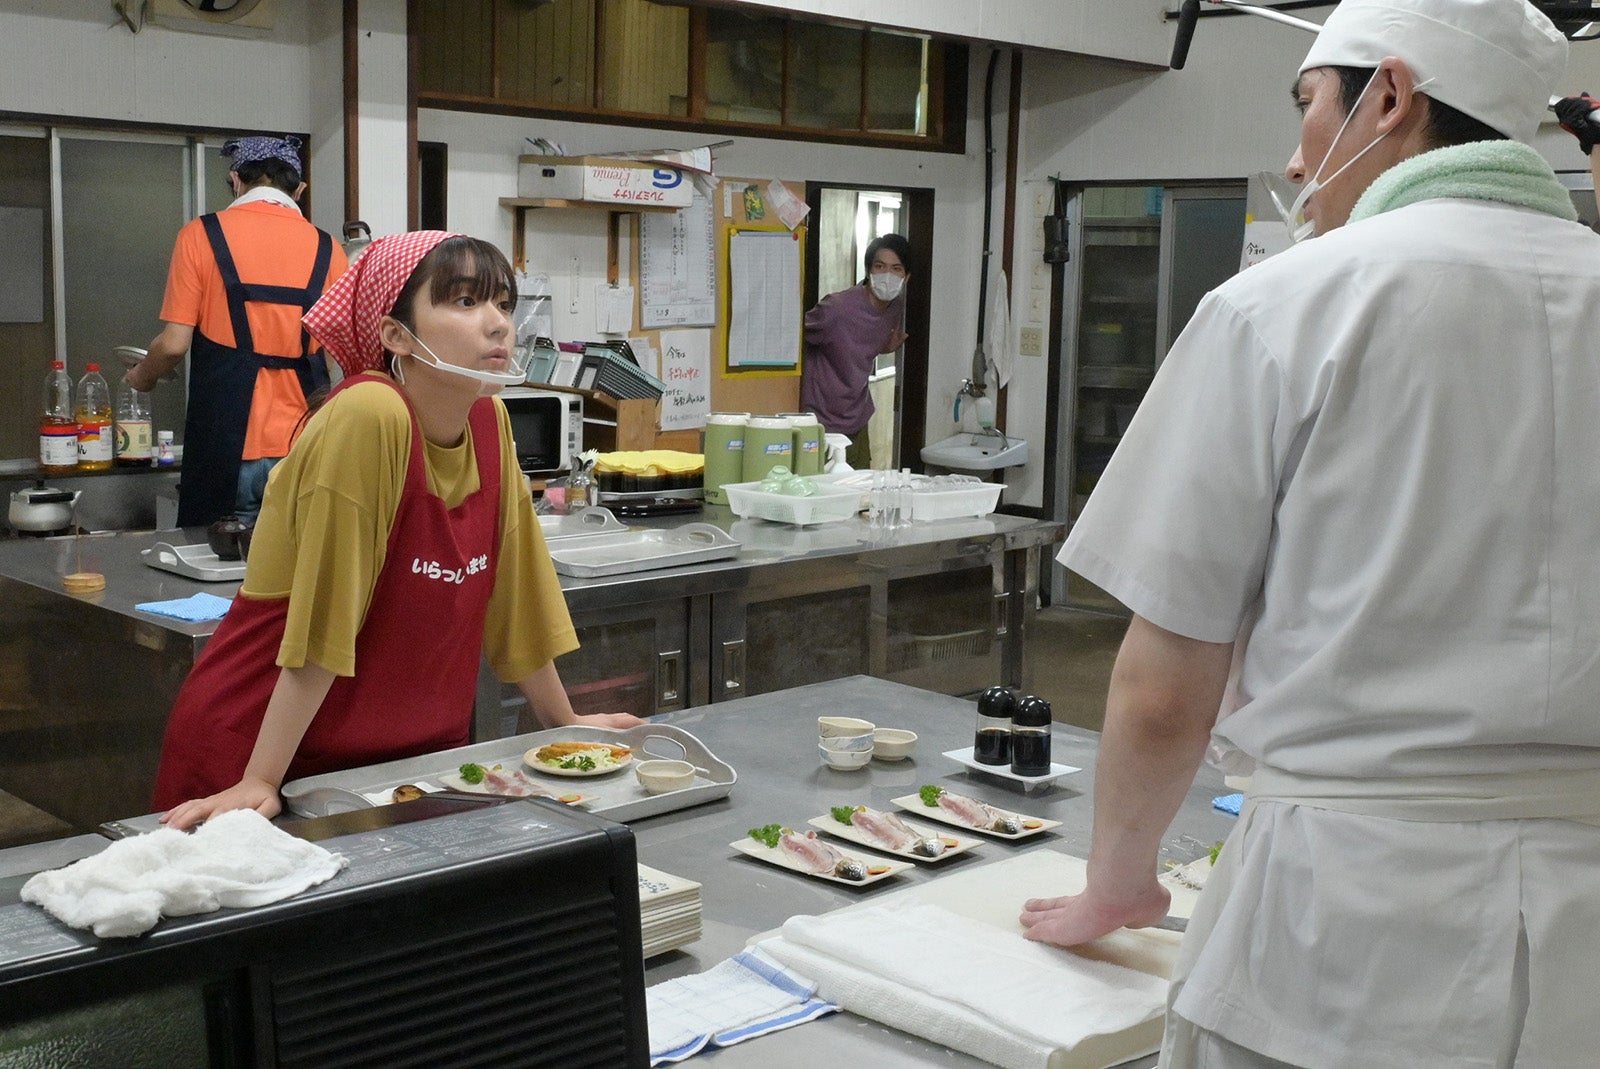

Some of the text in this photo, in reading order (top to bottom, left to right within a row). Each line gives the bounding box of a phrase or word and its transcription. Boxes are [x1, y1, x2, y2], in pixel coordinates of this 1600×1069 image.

[411, 553, 488, 585] いらっしませ
